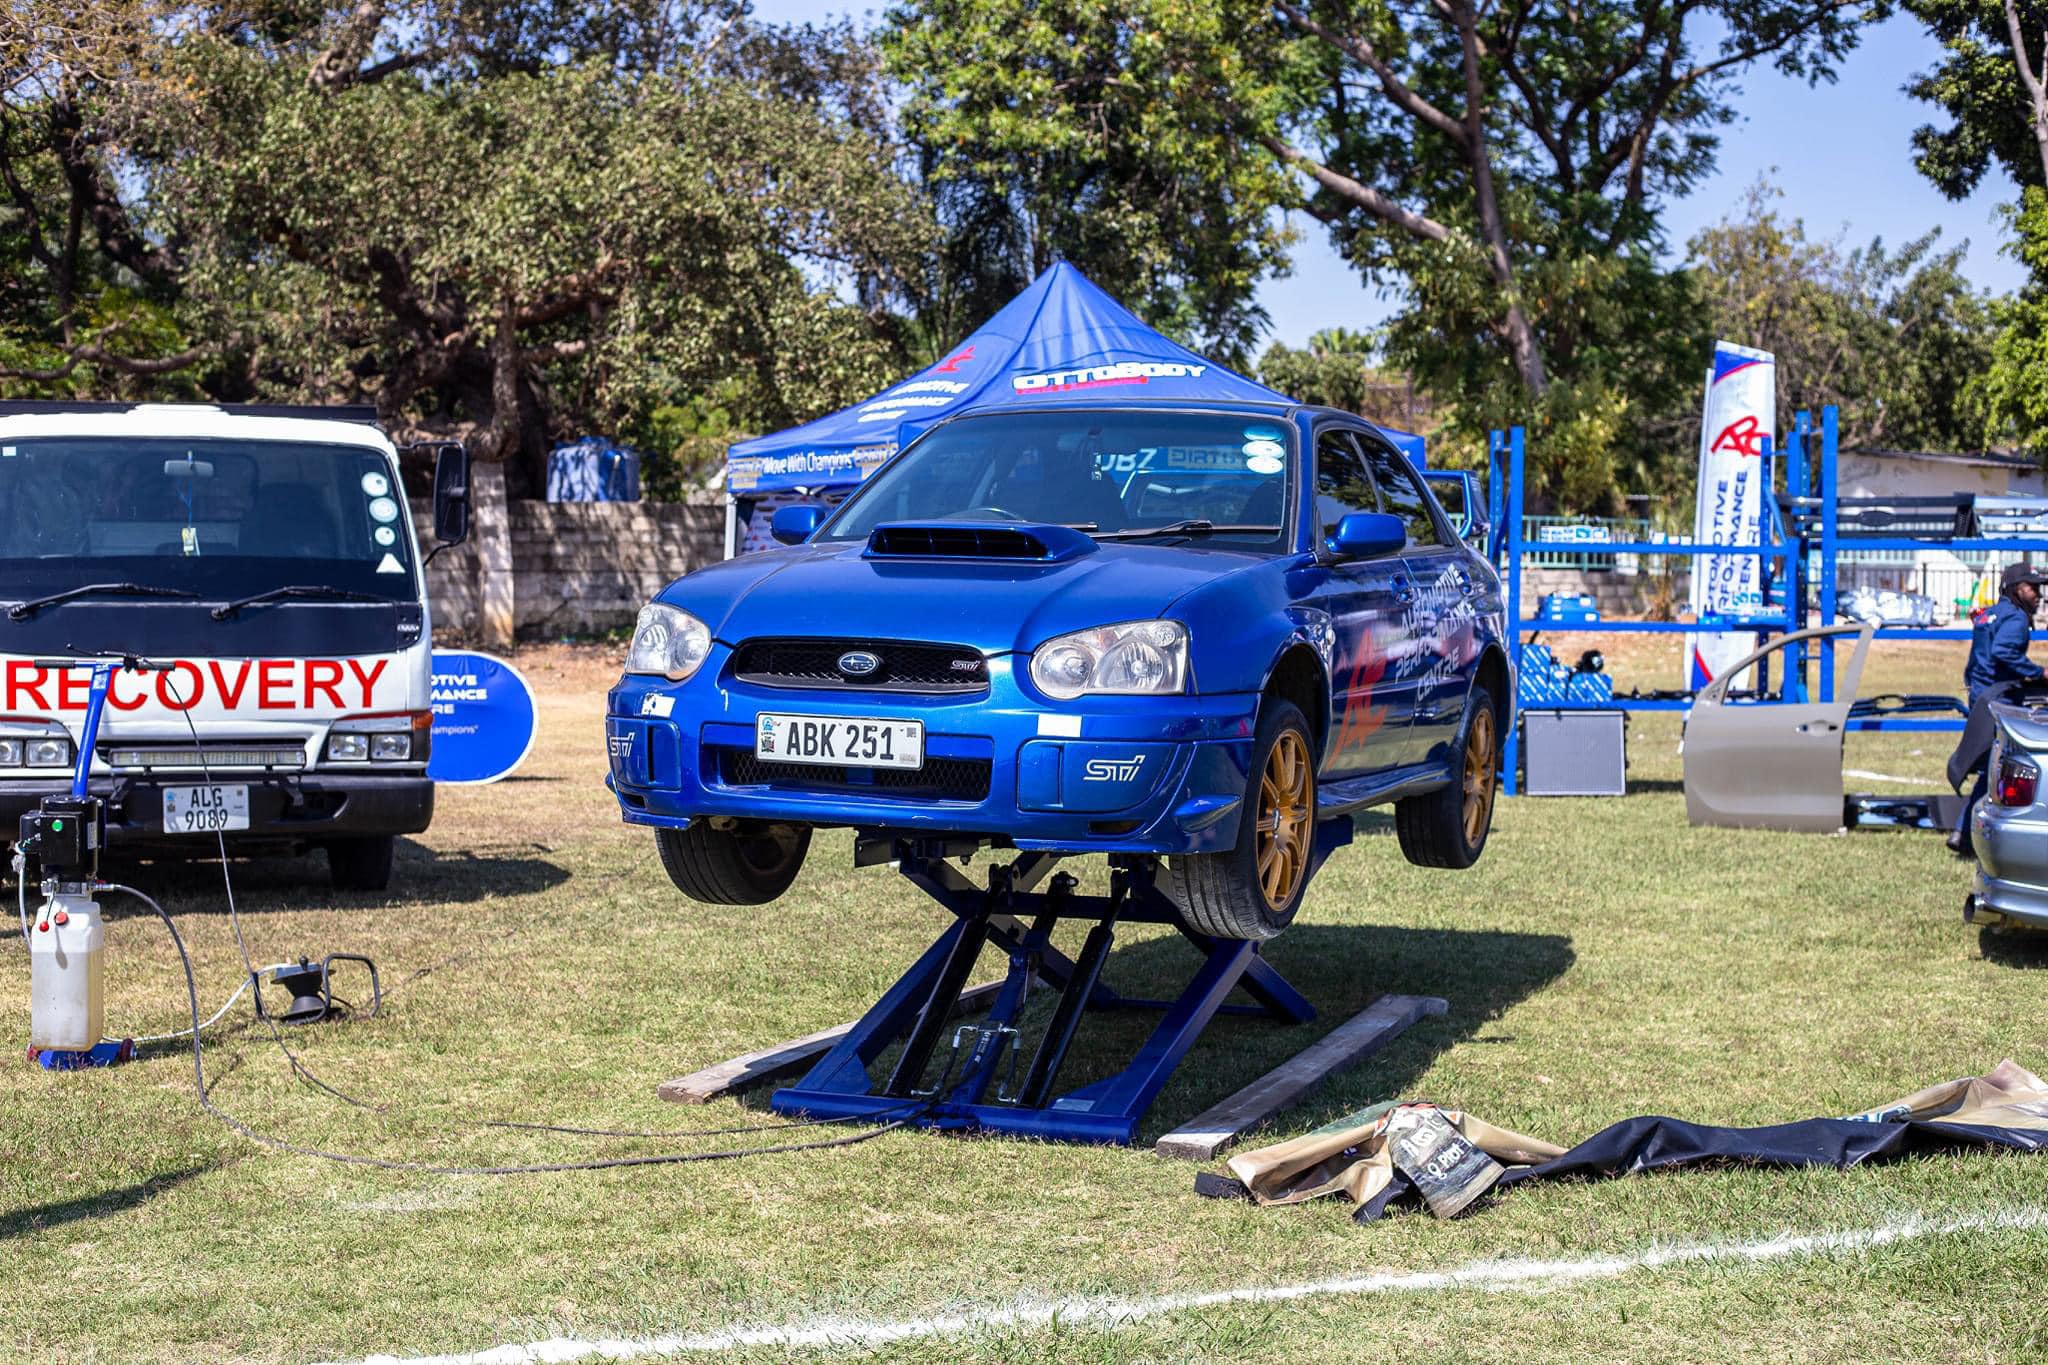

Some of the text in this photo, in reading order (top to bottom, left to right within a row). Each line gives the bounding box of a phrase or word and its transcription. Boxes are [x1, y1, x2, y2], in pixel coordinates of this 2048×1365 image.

[1707, 480, 1728, 607] UTOMOTIVE
[5, 659, 389, 712] RECOVERY
[786, 721, 895, 761] ABK 251
[191, 787, 223, 808] ALG
[185, 808, 228, 830] 9089
